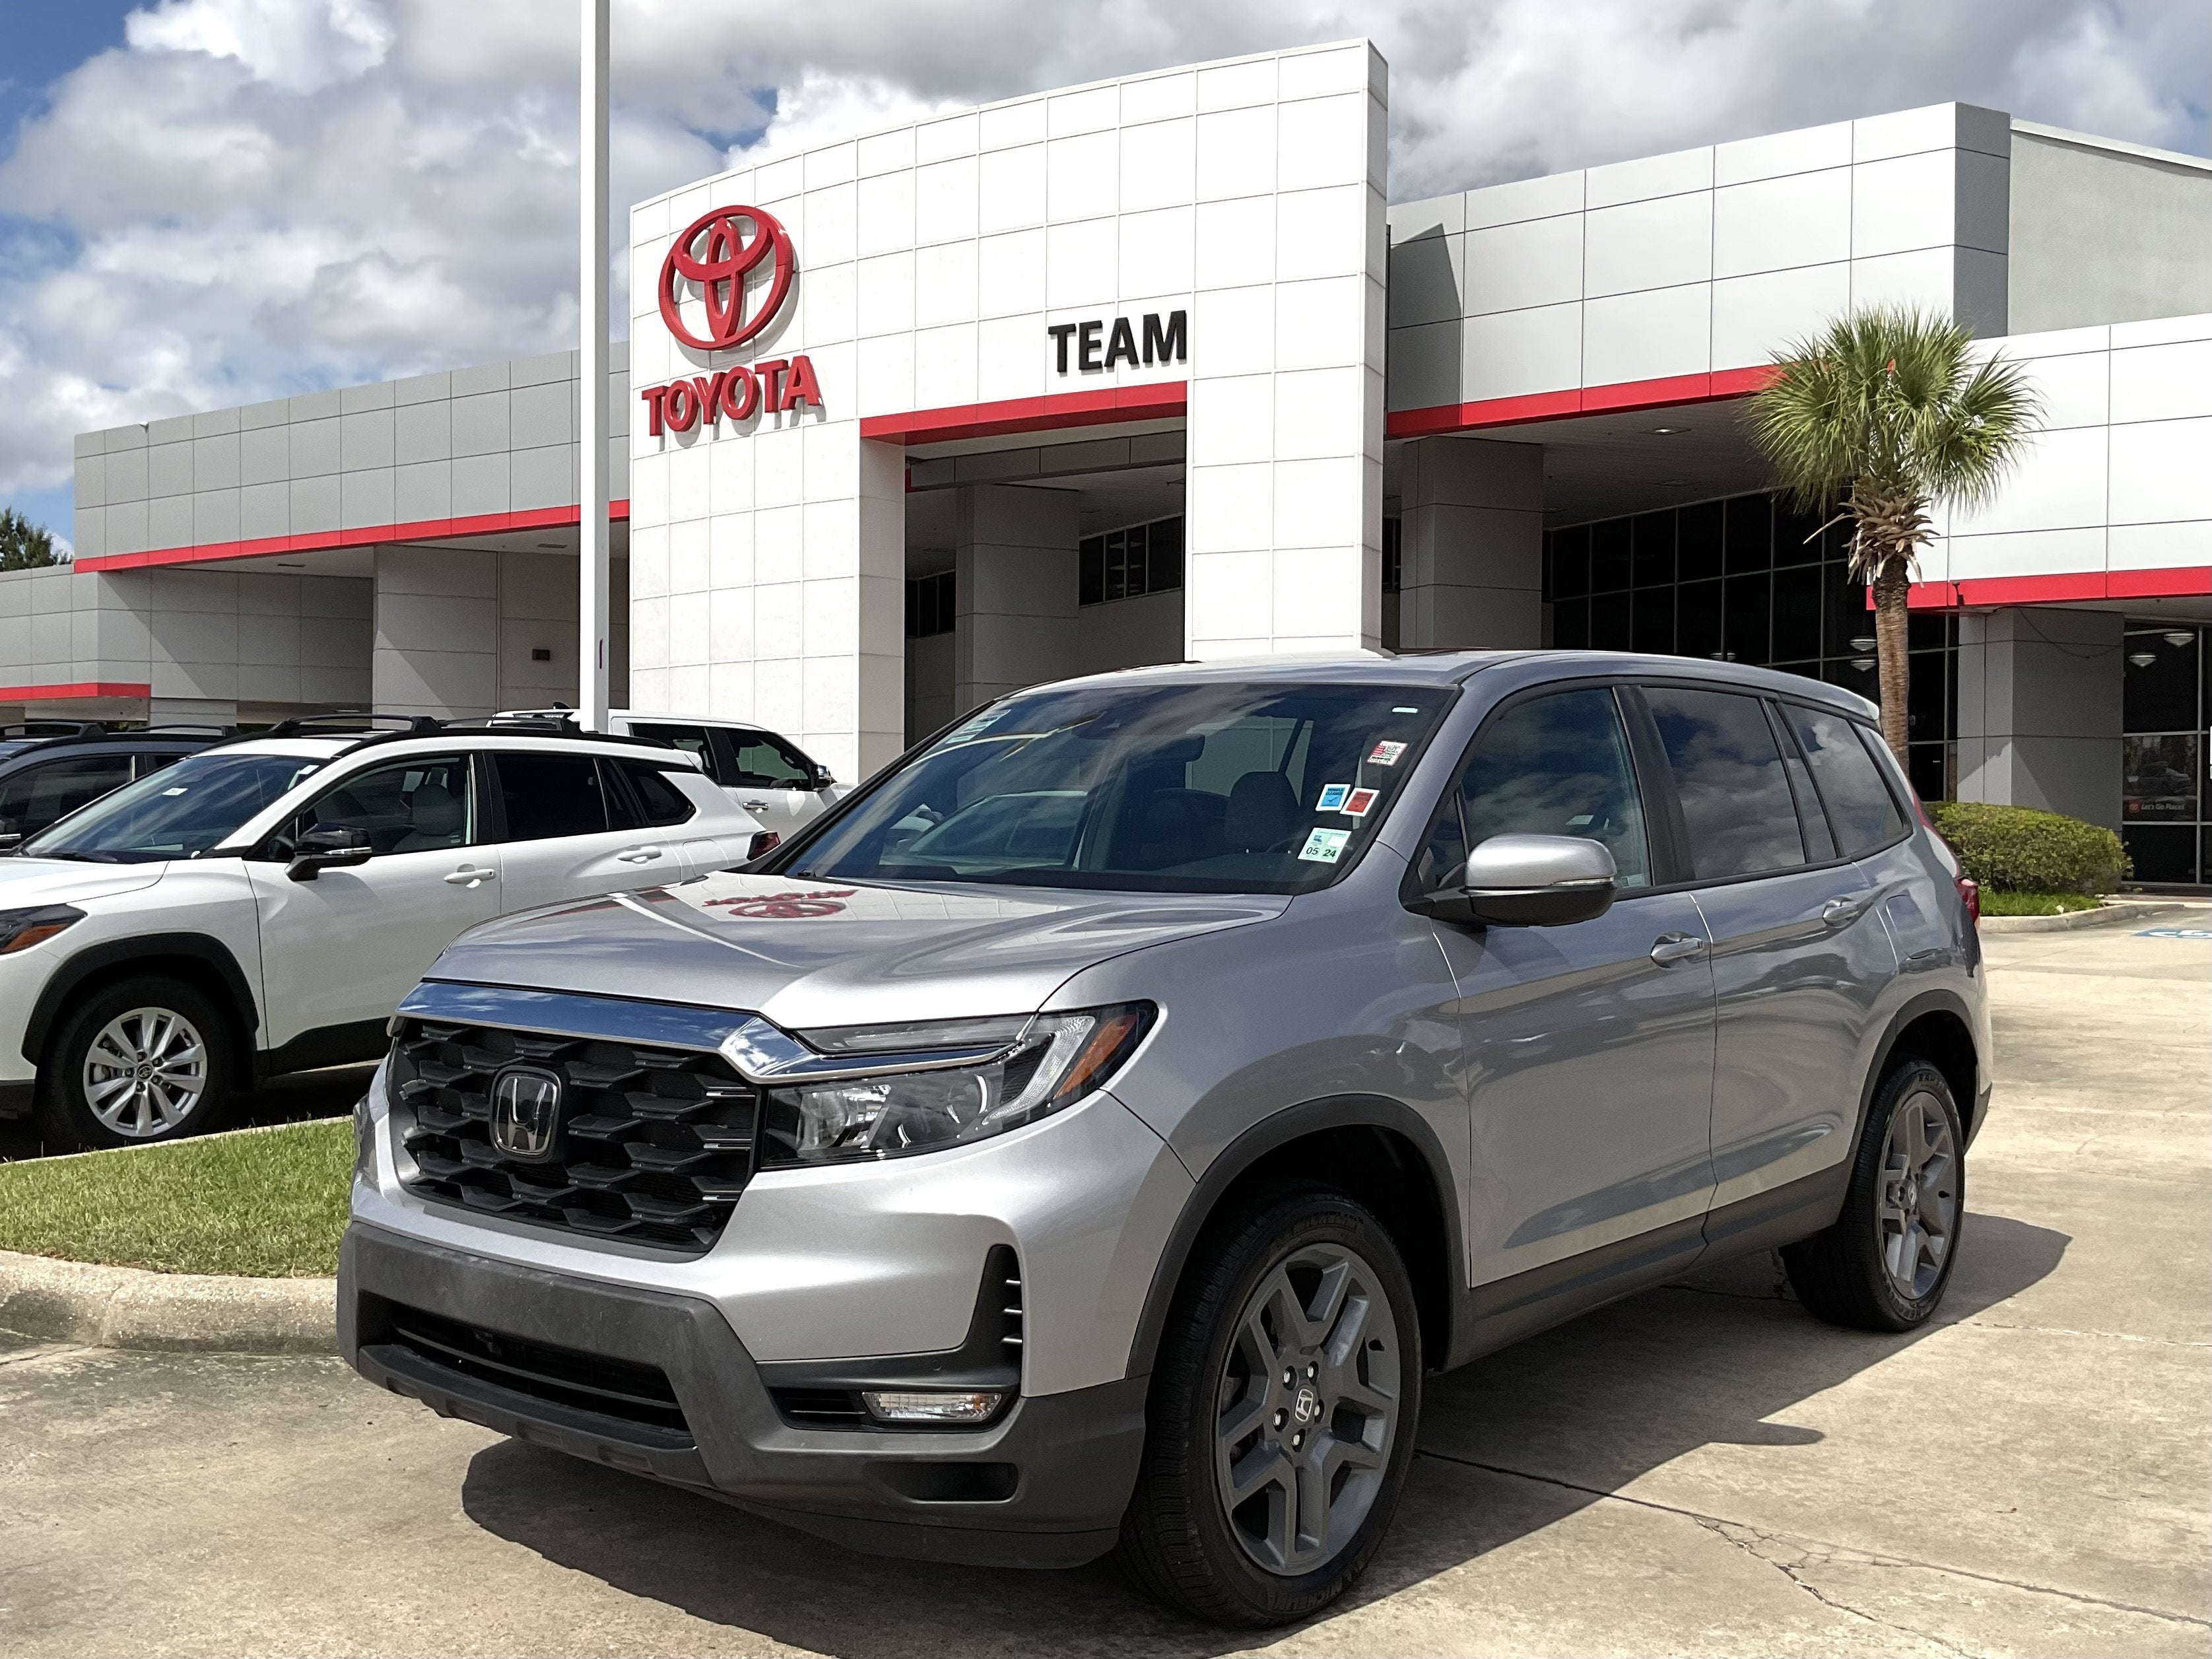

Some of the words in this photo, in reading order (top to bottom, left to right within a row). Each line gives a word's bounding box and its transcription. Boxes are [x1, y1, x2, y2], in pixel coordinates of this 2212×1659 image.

[1048, 310, 1187, 373] TEAM
[642, 355, 822, 437] TOYOTA
[1306, 847, 1320, 856] 05
[1323, 849, 1337, 858] 24
